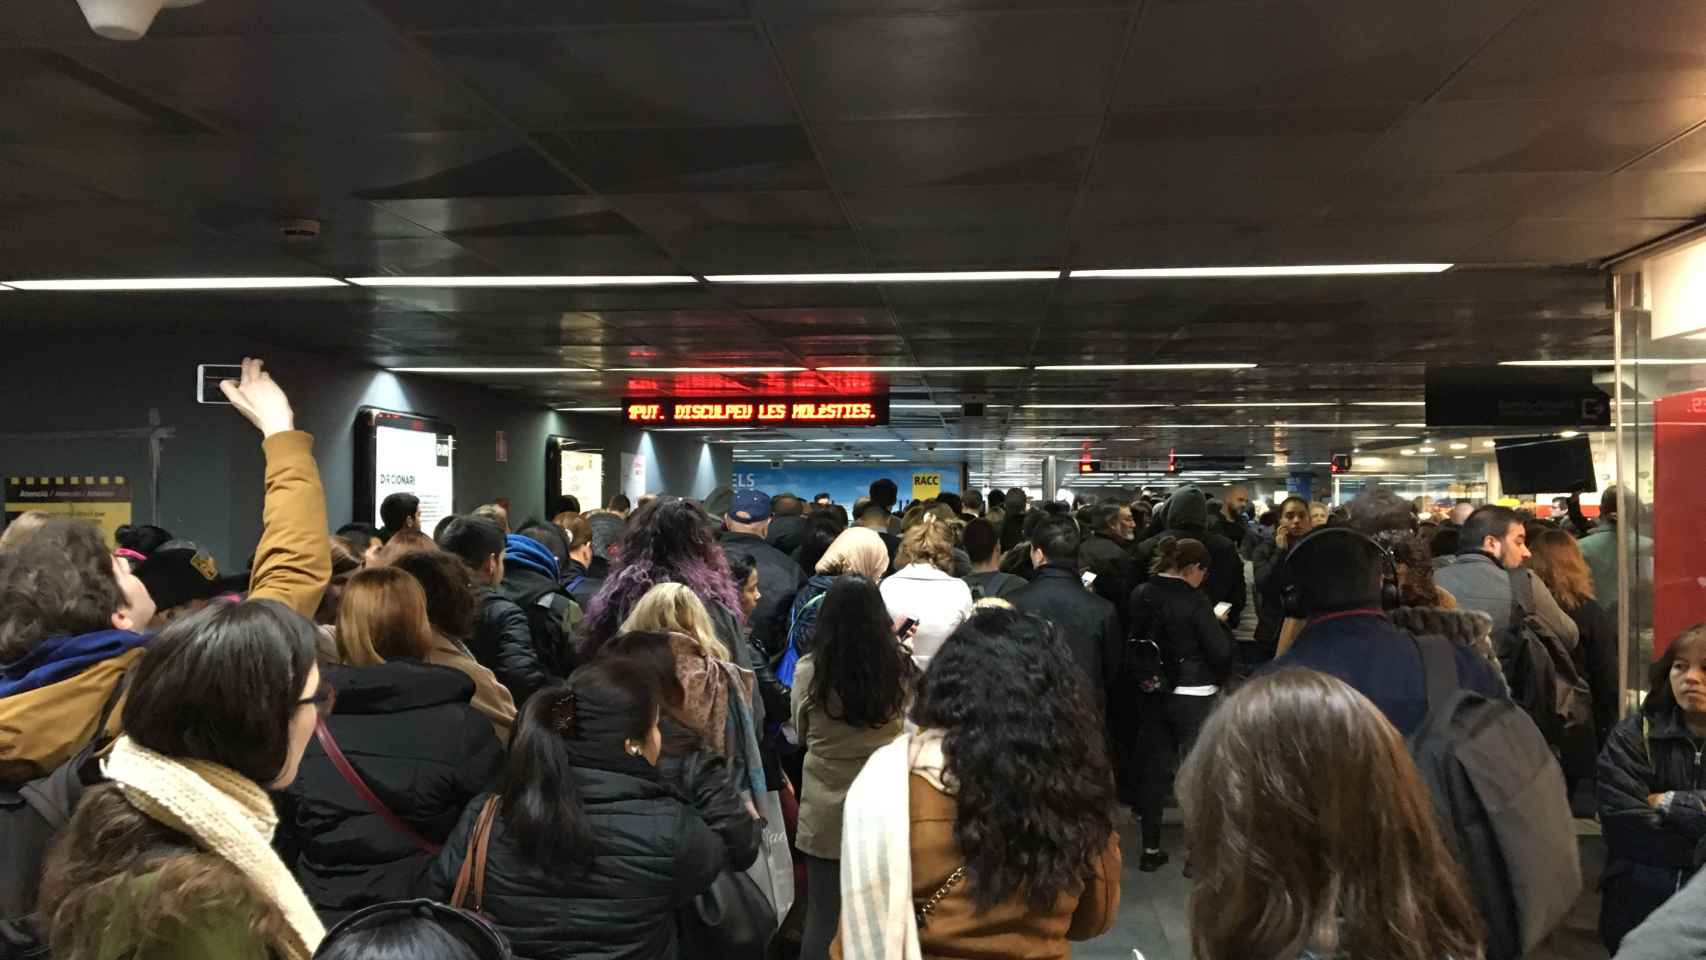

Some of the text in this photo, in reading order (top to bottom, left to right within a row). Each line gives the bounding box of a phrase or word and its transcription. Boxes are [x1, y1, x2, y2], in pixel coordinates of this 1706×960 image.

[673, 404, 753, 419] DISCULPEU
[758, 404, 786, 419] LES
[914, 475, 939, 486] RACC
